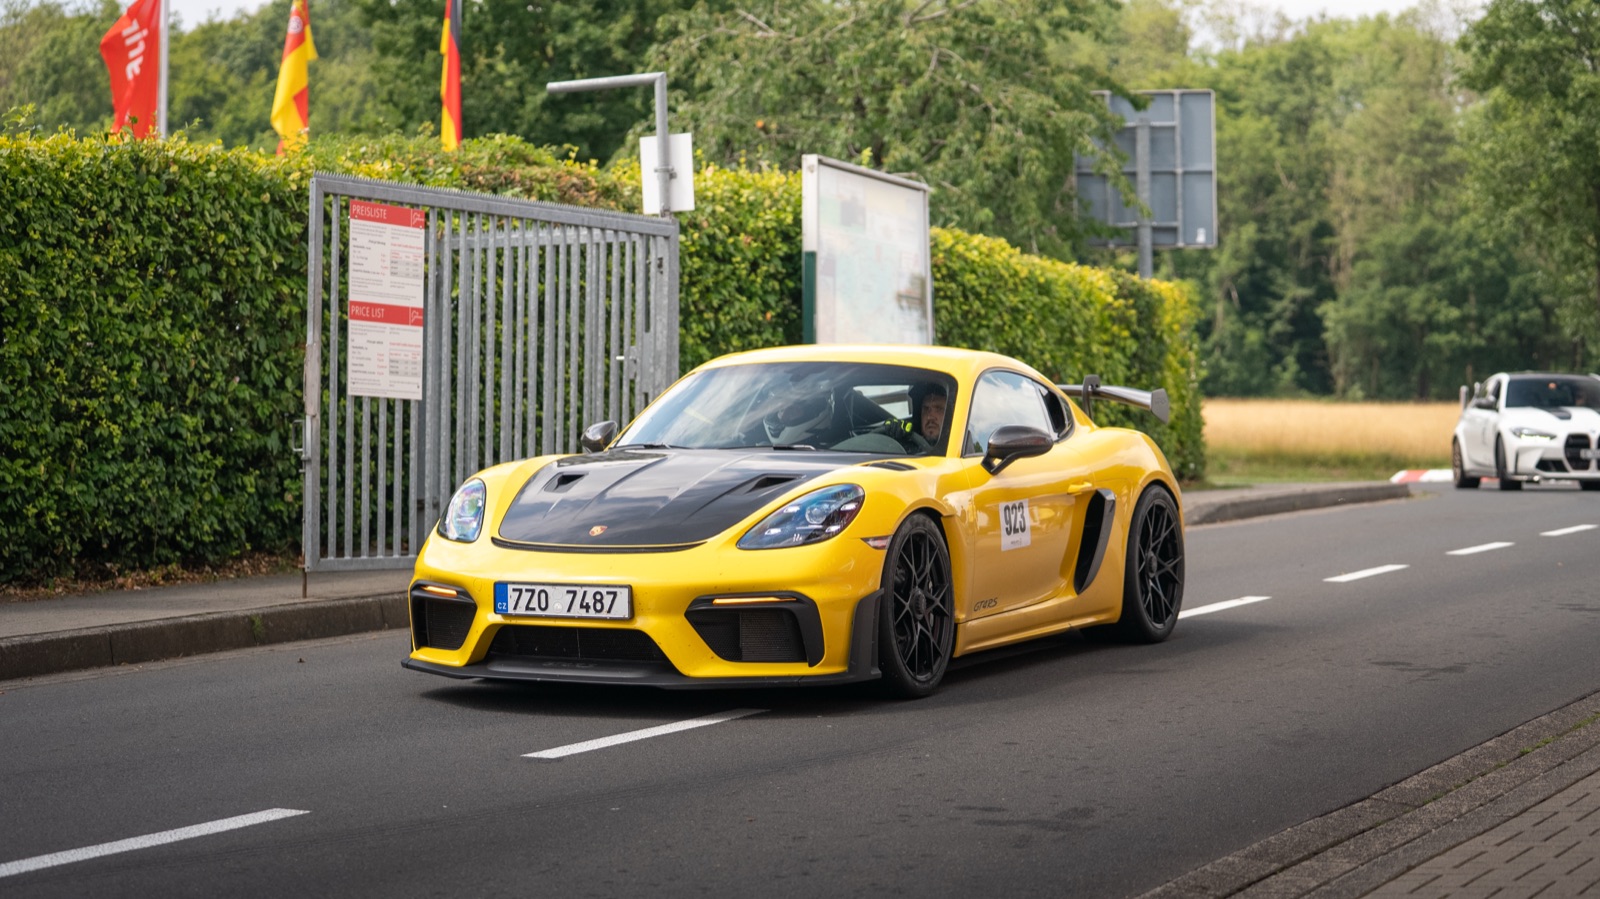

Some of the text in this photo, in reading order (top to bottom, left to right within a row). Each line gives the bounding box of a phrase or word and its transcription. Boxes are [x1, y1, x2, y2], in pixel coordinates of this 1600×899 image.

[352, 204, 387, 219] PREISLISTE
[351, 305, 385, 318] PRICE LIST
[1004, 501, 1026, 536] 923
[497, 602, 507, 610] CZ
[512, 588, 618, 614] 7Z0 7487
